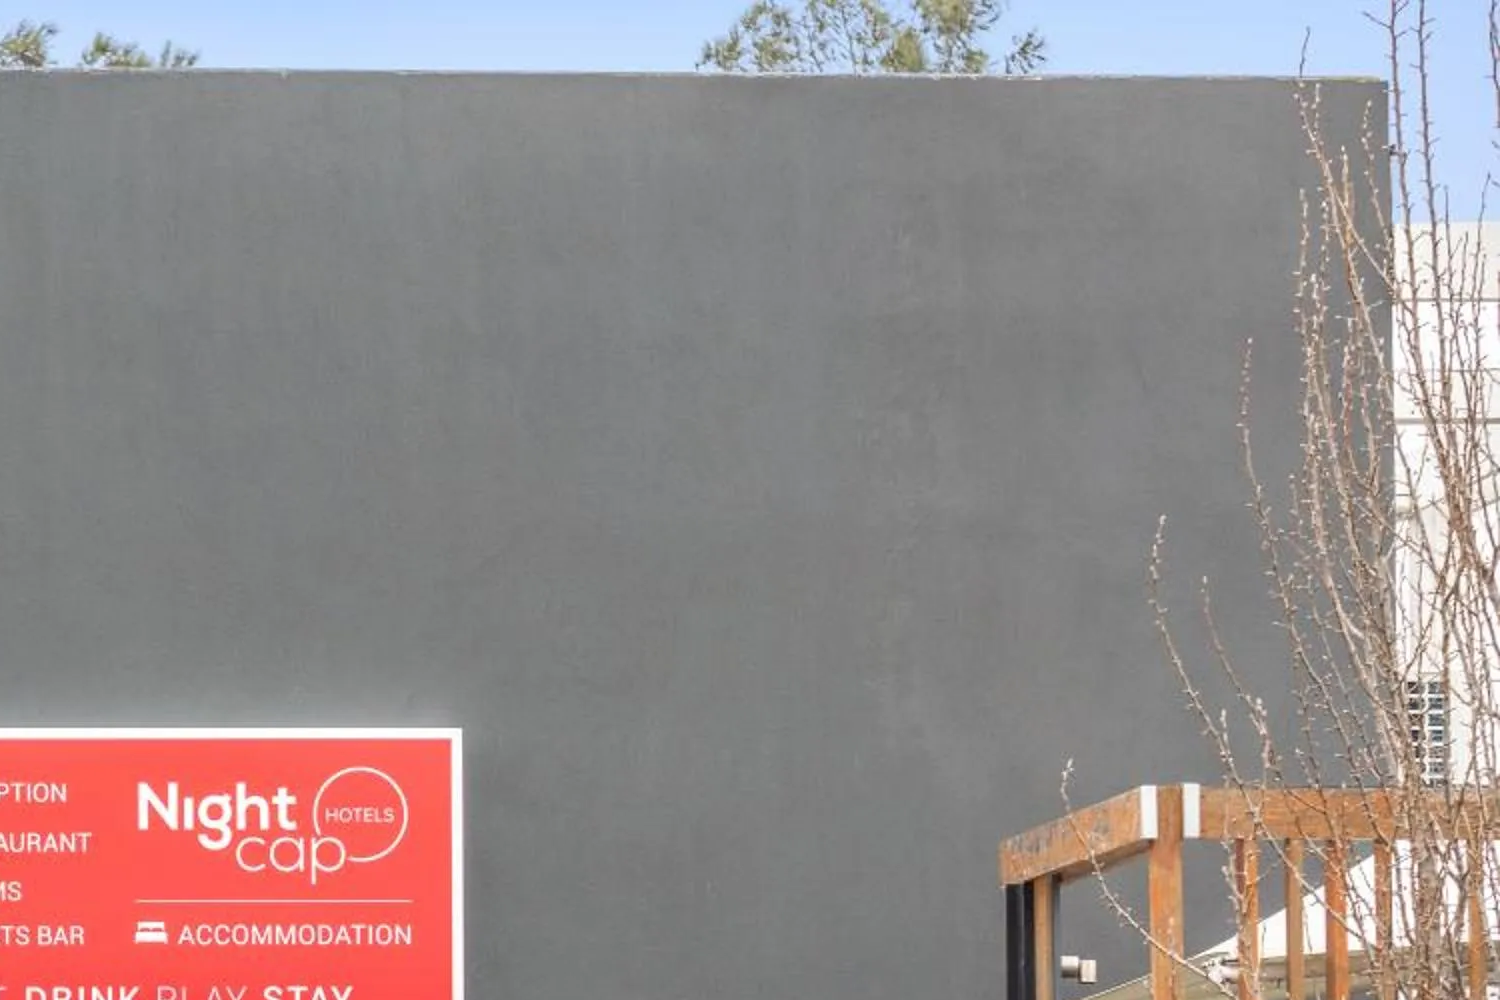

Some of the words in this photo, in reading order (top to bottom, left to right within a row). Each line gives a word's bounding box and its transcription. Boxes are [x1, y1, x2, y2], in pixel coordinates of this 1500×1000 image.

[137, 782, 297, 850] Night
[326, 808, 394, 822] HOTELS
[236, 836, 346, 884] cap
[37, 925, 84, 945] BAR
[178, 924, 411, 945] ACCOMMODATION
